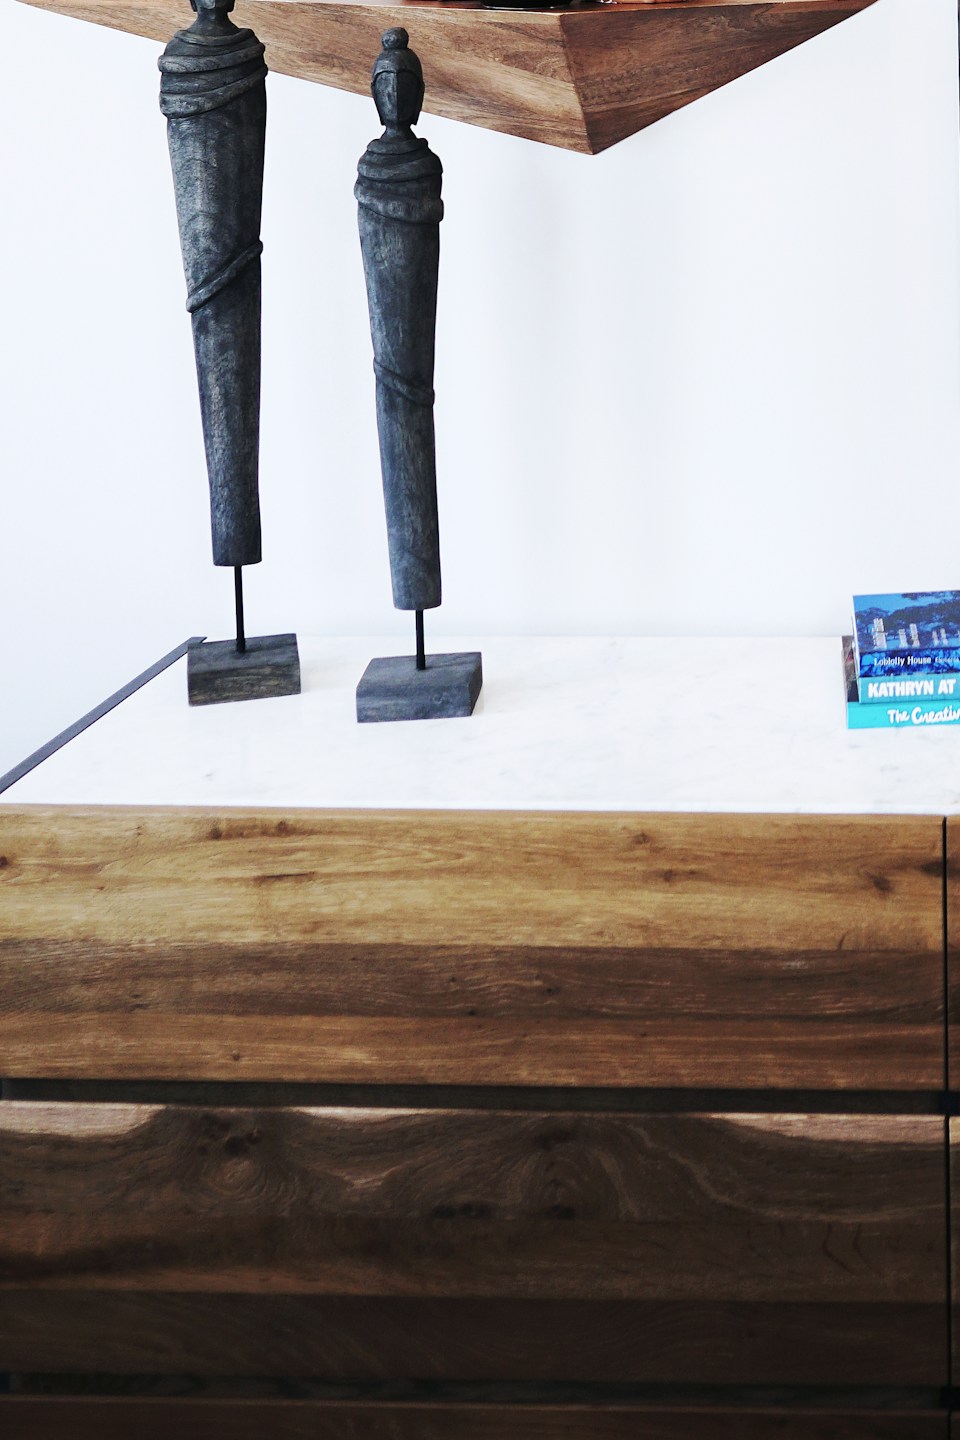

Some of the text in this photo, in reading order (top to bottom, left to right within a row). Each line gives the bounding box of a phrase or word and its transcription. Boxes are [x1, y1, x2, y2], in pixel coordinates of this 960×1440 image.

[873, 656, 905, 667] Loblolly
[907, 655, 931, 665] House
[868, 680, 934, 697] KATHRYN
[938, 679, 956, 694] AT
[888, 709, 910, 724] The
